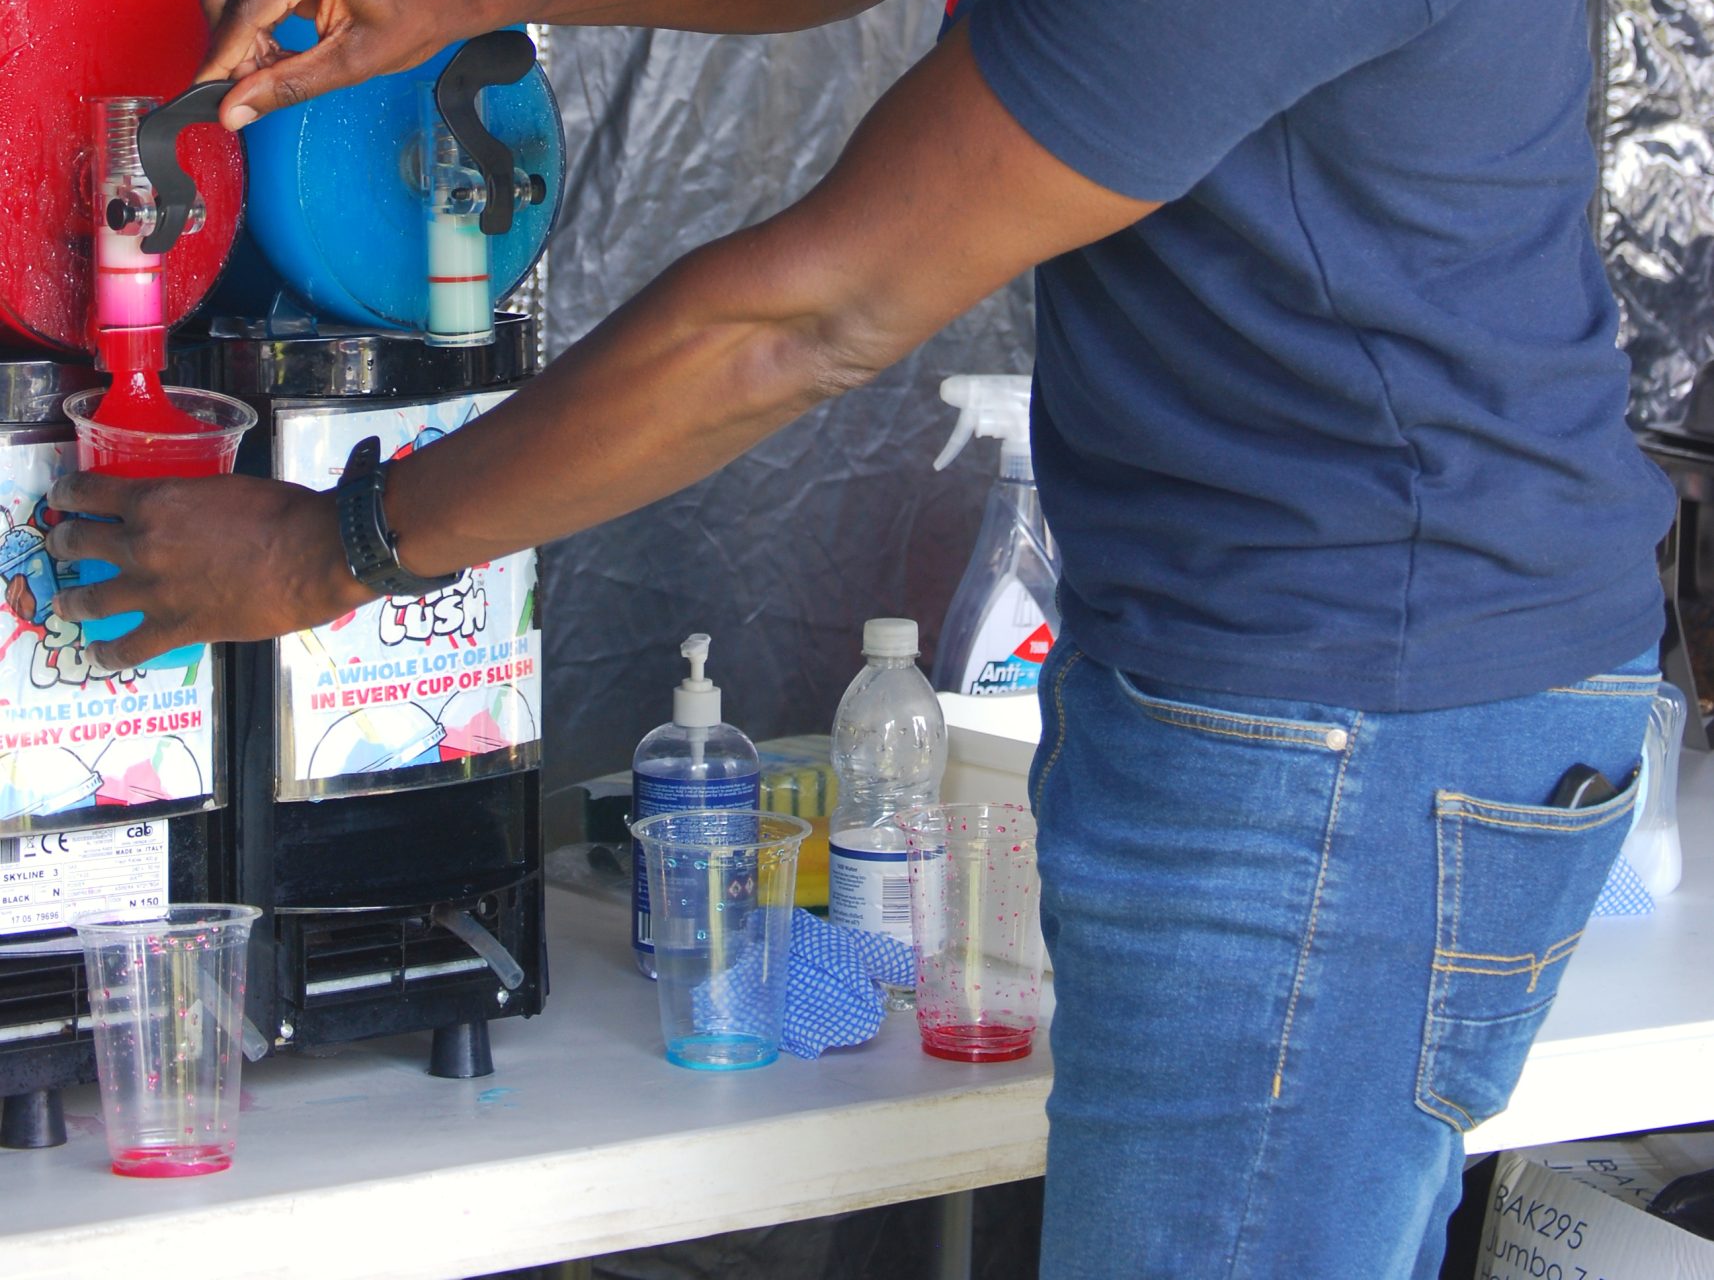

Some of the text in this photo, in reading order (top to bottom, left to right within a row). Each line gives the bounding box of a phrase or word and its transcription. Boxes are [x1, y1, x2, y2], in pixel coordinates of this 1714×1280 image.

[379, 587, 487, 647] LUSH
[30, 640, 147, 689] LU
[316, 637, 528, 687] A WHOLE LOT OF LUSH
[979, 662, 1025, 682] Anti-
[311, 658, 534, 710] IN EVERY CUP OF SLUSH
[77, 698, 117, 719] LOT
[120, 694, 148, 713] OF
[153, 688, 197, 710] LUSH
[69, 722, 111, 743] CUP
[115, 715, 142, 737] OF
[146, 710, 201, 733] SLUSH
[115, 847, 133, 855] MADE
[145, 844, 164, 852] ITALY
[3, 868, 59, 882] SKYLINE 3
[2, 895, 30, 904] BLACK
[52, 888, 61, 897] N
[129, 899, 137, 908] N
[140, 896, 159, 906] 150
[1494, 1184, 1588, 1250] BAK295
[1485, 1225, 1563, 1280] Jumbo
